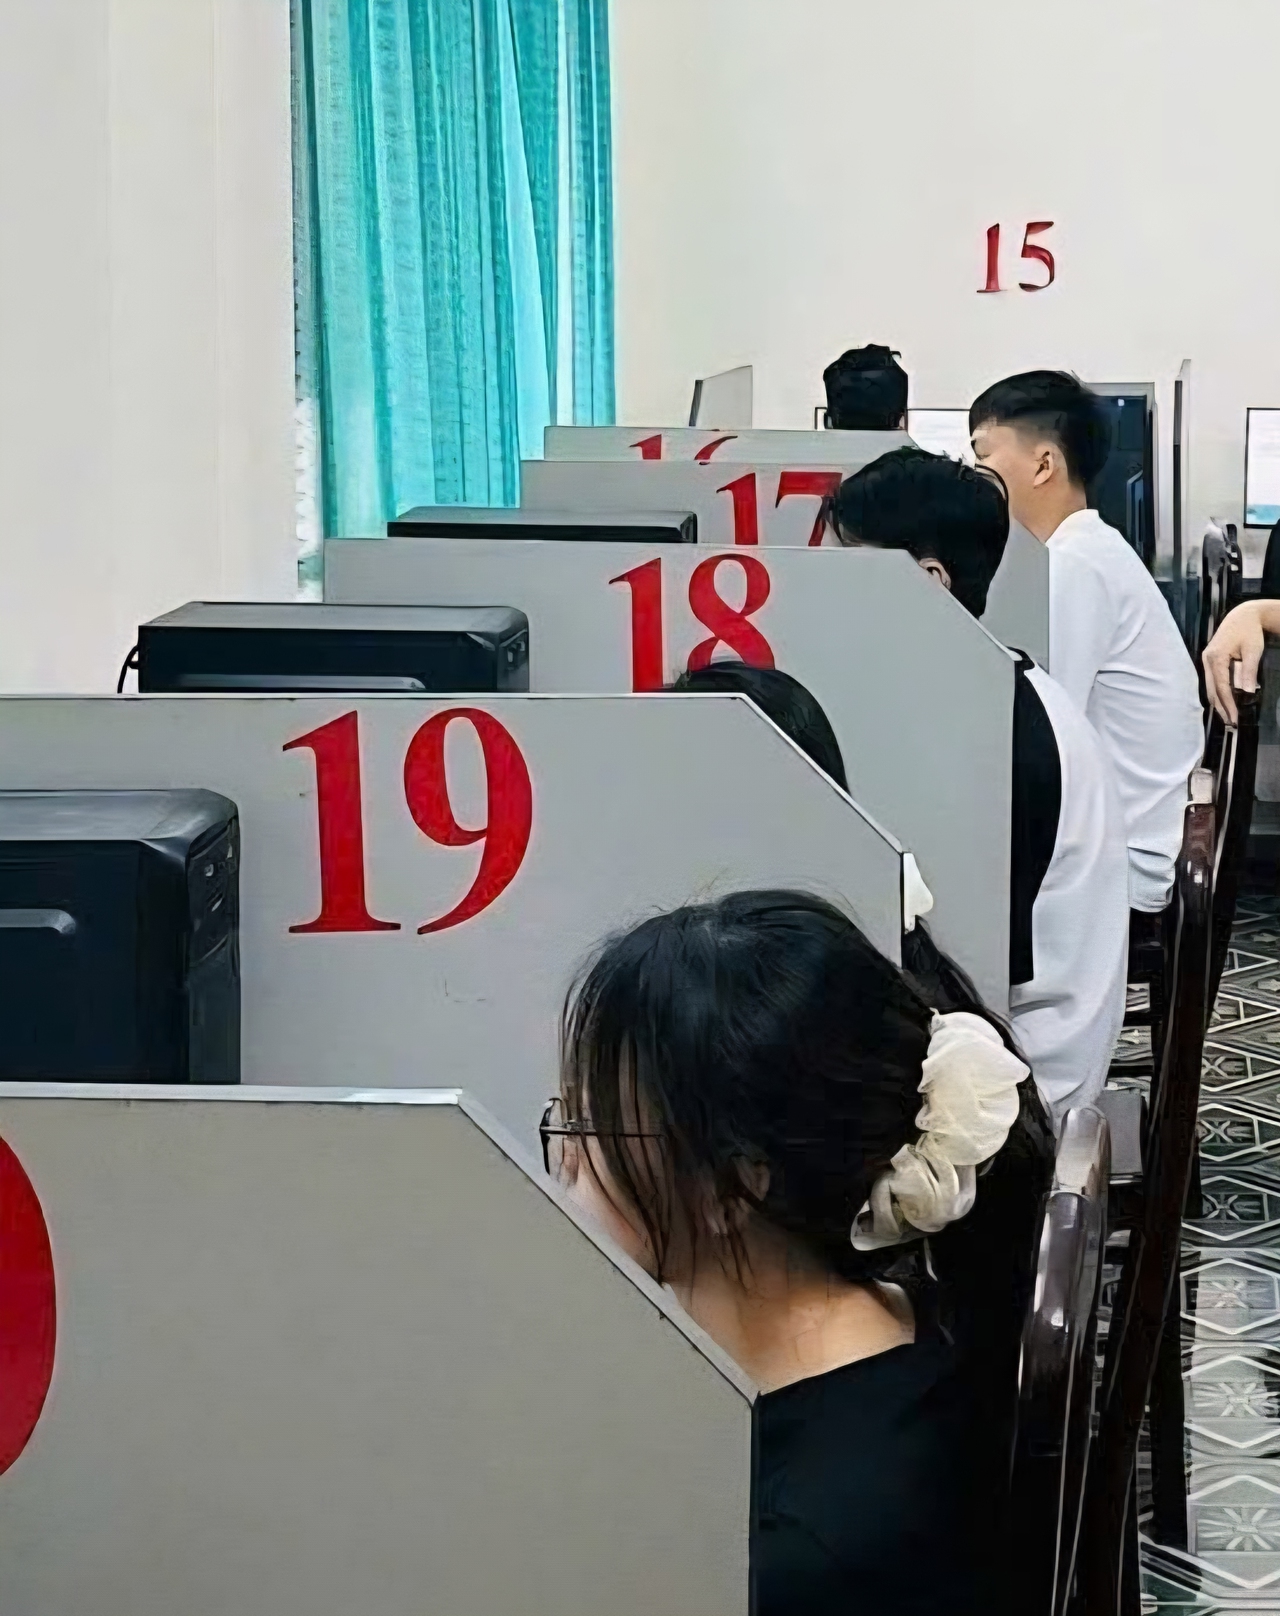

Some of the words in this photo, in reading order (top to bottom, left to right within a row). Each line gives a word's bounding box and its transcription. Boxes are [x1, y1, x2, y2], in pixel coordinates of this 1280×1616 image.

[976, 221, 1055, 293] 15
[716, 471, 843, 547] 17
[608, 553, 775, 693] 18
[283, 707, 534, 935] 19
